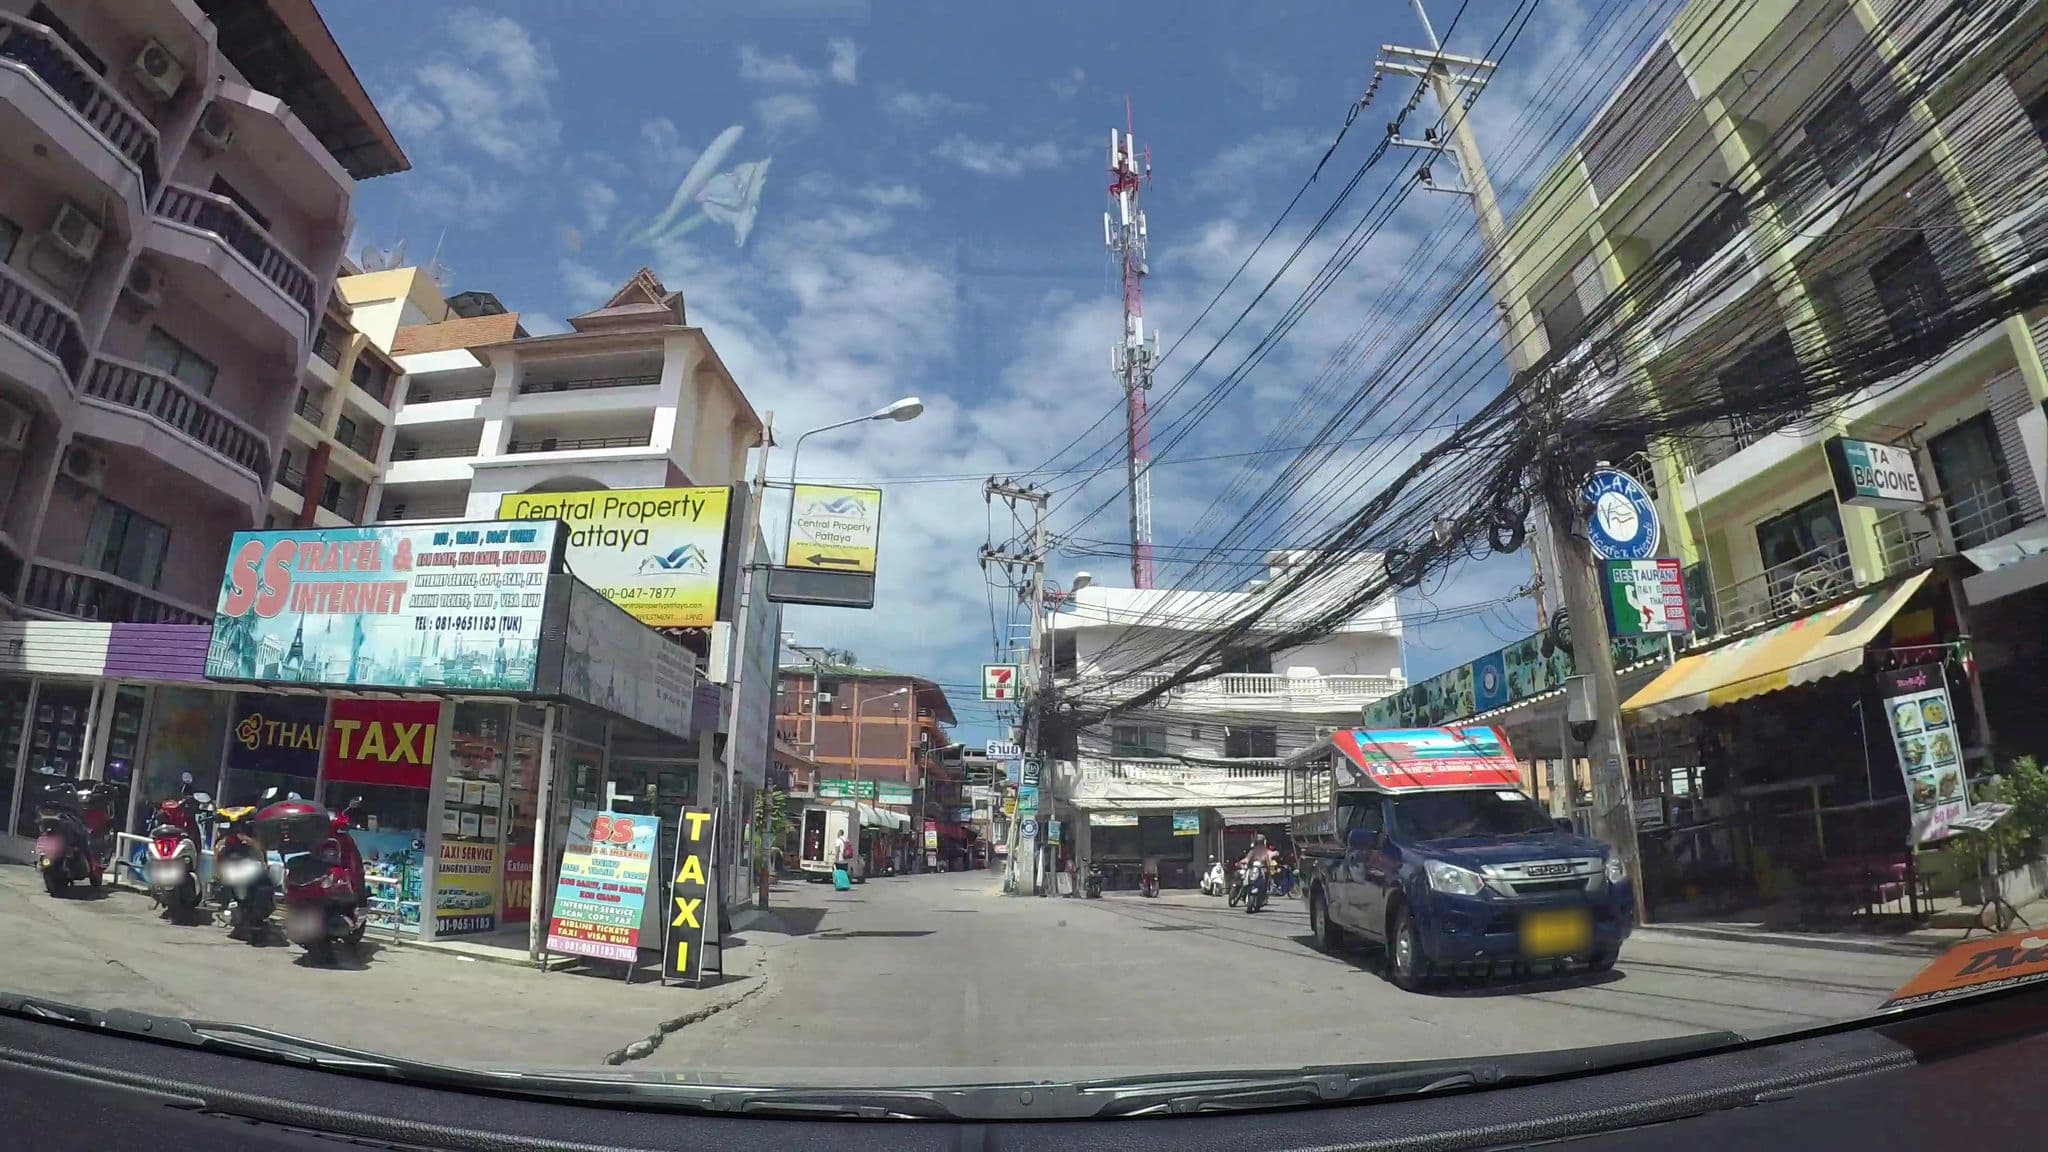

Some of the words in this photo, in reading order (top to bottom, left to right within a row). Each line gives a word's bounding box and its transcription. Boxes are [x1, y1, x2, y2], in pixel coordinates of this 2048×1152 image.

[1870, 447, 1890, 464] TA
[1854, 466, 1917, 492] BACIONE
[516, 497, 595, 520] Central
[604, 494, 706, 523] Property
[798, 519, 829, 530] Central
[833, 521, 870, 534] Property
[815, 532, 851, 543] Pattaya
[297, 541, 382, 573] TRAVEL
[393, 538, 413, 573] &
[224, 539, 298, 618] SS
[415, 573, 448, 587] INTERNET
[526, 573, 543, 586] FAX
[1614, 569, 1678, 583] RESTAURANT
[290, 581, 409, 614] INTERNET
[500, 593, 519, 607] VISA
[521, 593, 541, 607] RUN
[415, 616, 426, 630] TEL
[498, 616, 522, 634] (TUK)
[334, 720, 436, 764] TAXI
[590, 815, 634, 844] SS
[440, 845, 460, 858] TAXI
[462, 846, 493, 860] SERVICE
[671, 813, 711, 972] TAXI
[560, 900, 598, 911] INTERNET
[560, 919, 593, 931] AIRLINE
[596, 924, 629, 936] TICKETS
[615, 916, 631, 925] FAX
[557, 927, 577, 937] TAXI
[587, 932, 606, 942] VISA
[610, 935, 629, 945] RUN
